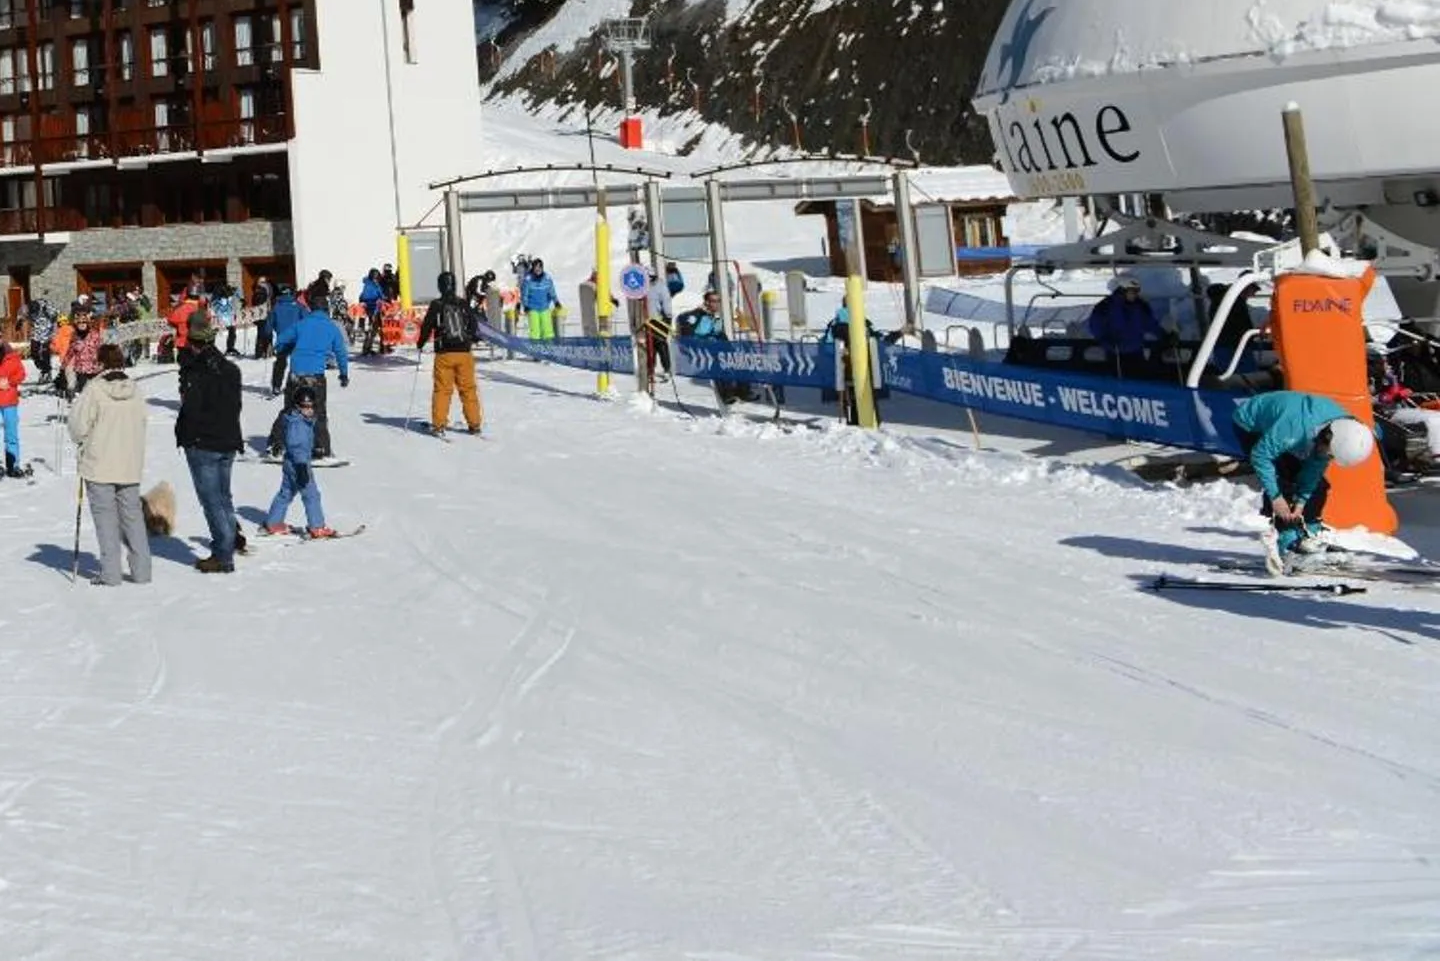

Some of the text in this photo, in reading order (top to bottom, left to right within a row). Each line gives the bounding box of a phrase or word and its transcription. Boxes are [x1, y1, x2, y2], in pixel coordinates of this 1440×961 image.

[1293, 298, 1352, 313] FLAINE
[942, 366, 1045, 407] BIENVENUE
[1057, 386, 1169, 428] WELCOME
